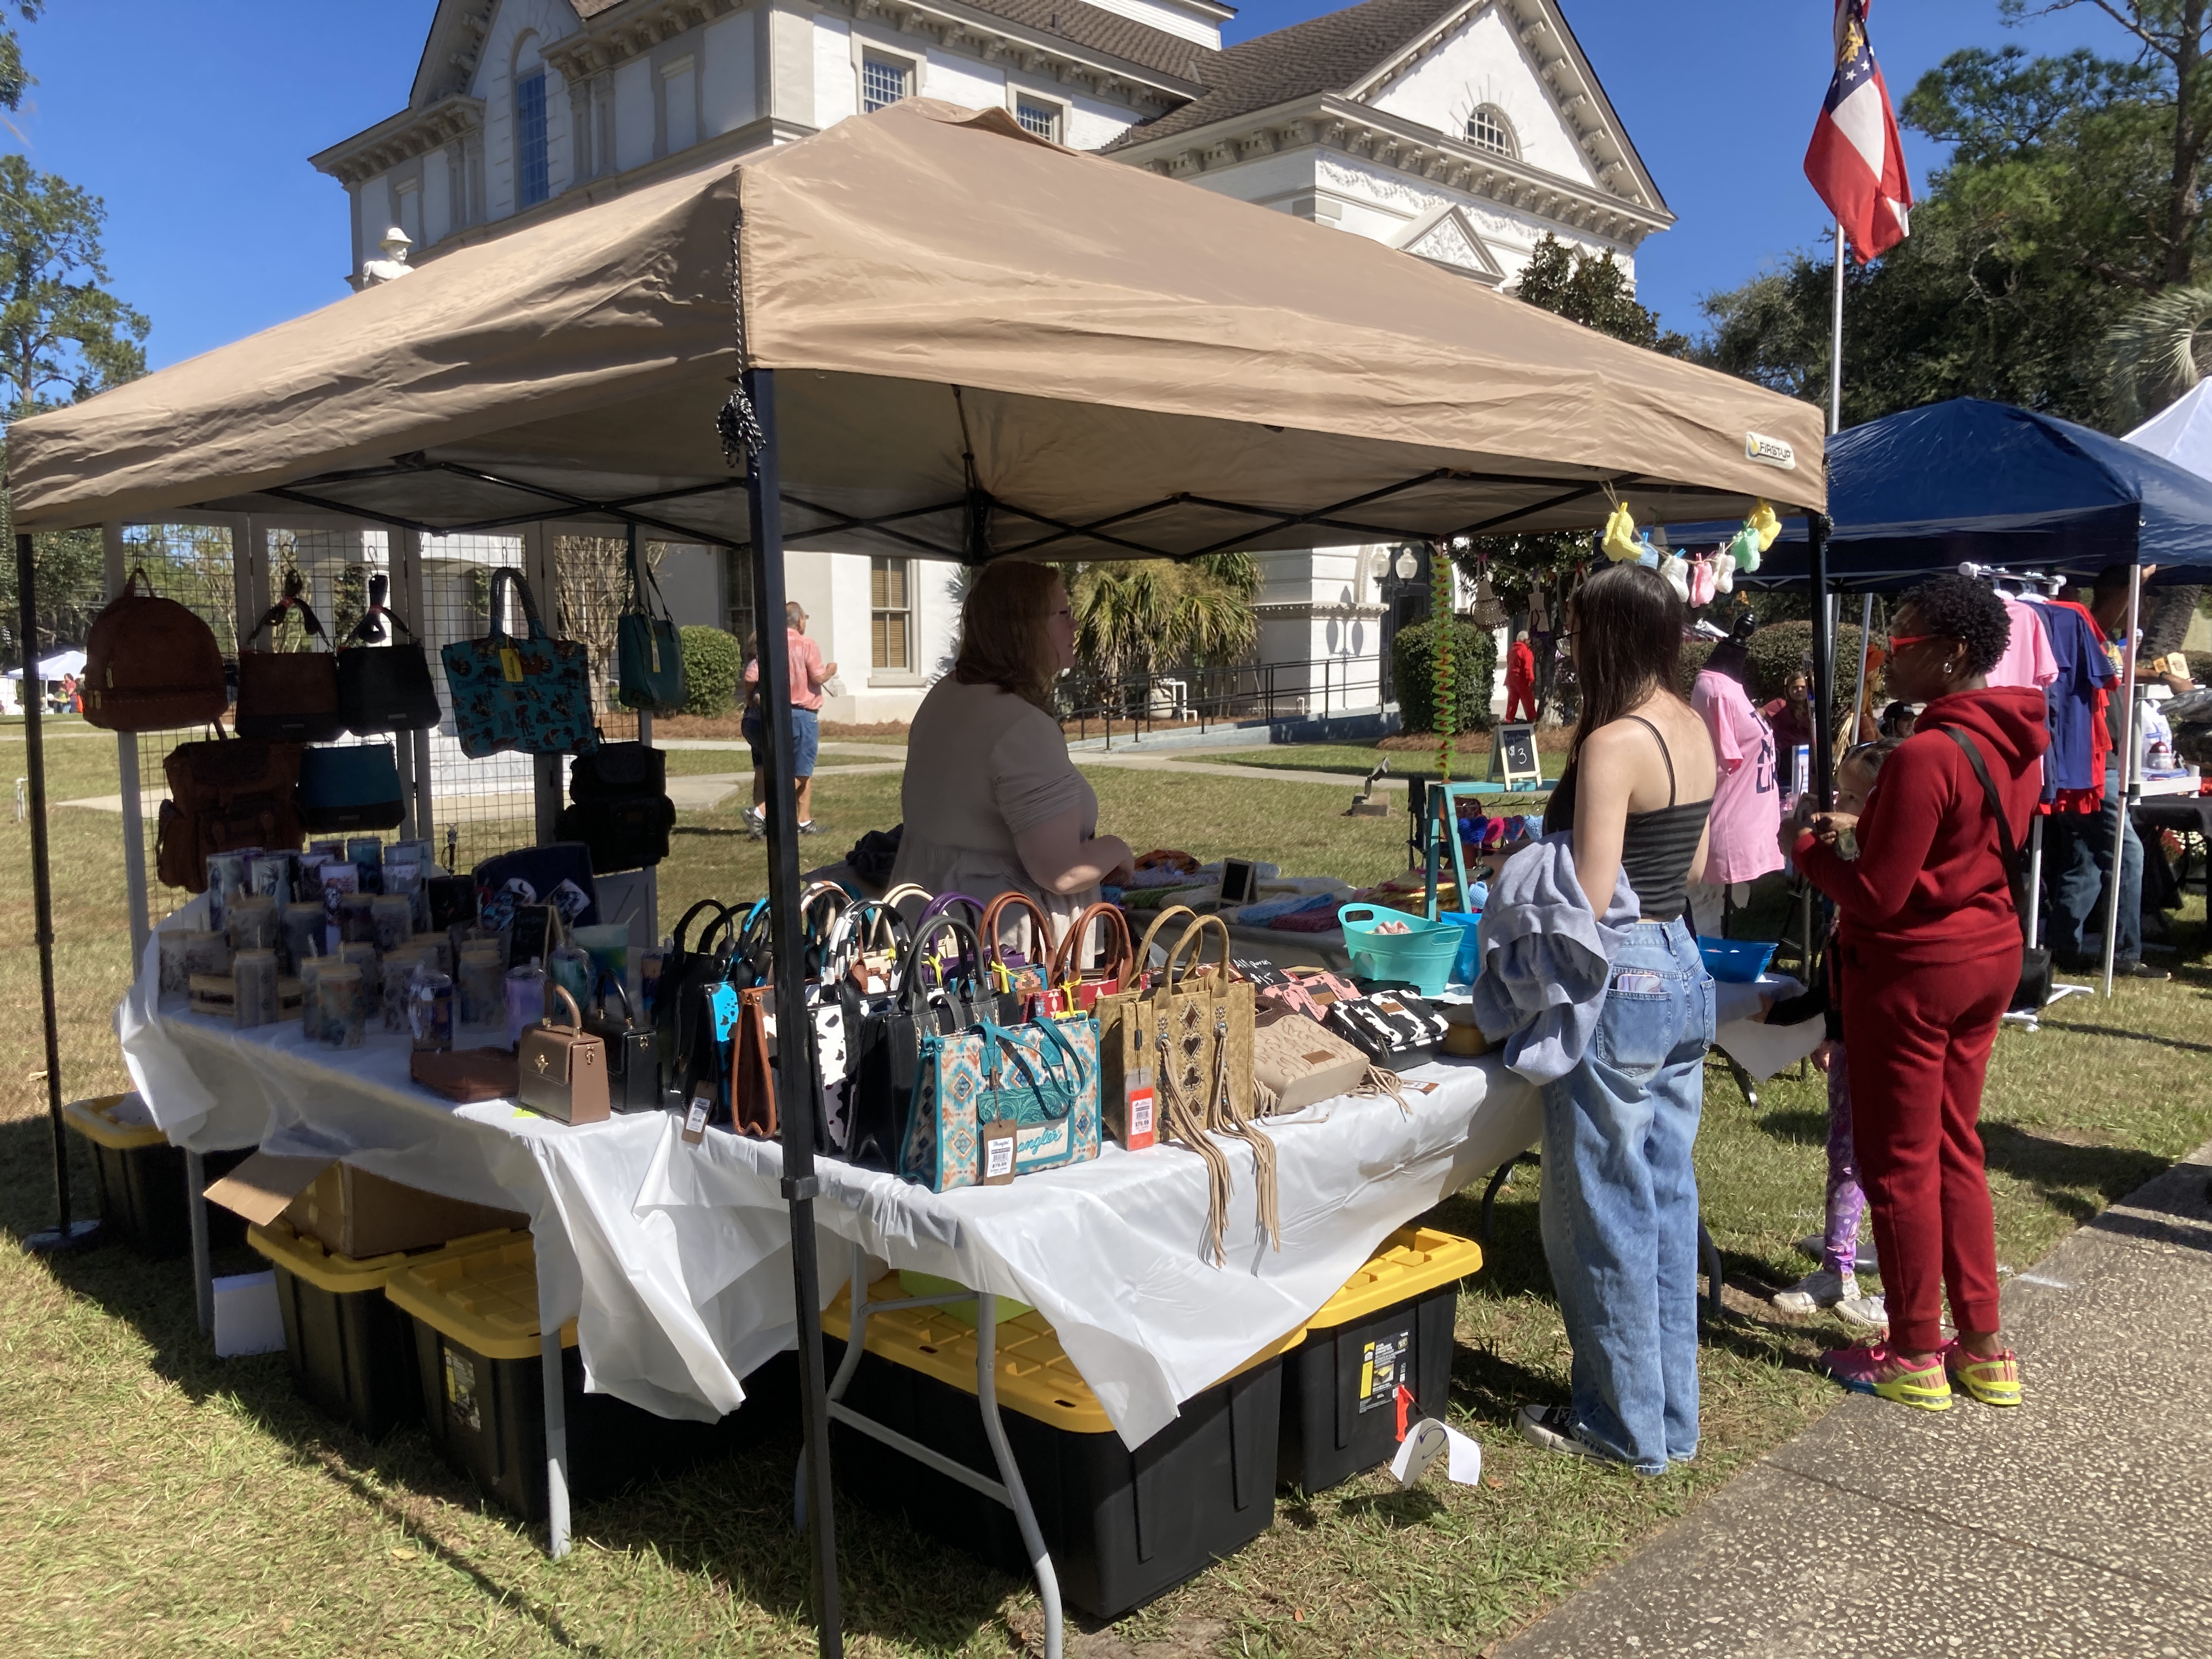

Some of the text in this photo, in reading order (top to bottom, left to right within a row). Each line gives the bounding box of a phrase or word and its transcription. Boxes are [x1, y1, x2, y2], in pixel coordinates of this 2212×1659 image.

[1232, 958, 1272, 969] All purses
[1249, 972, 1274, 986] $15
[1017, 1128, 1063, 1155] angler
